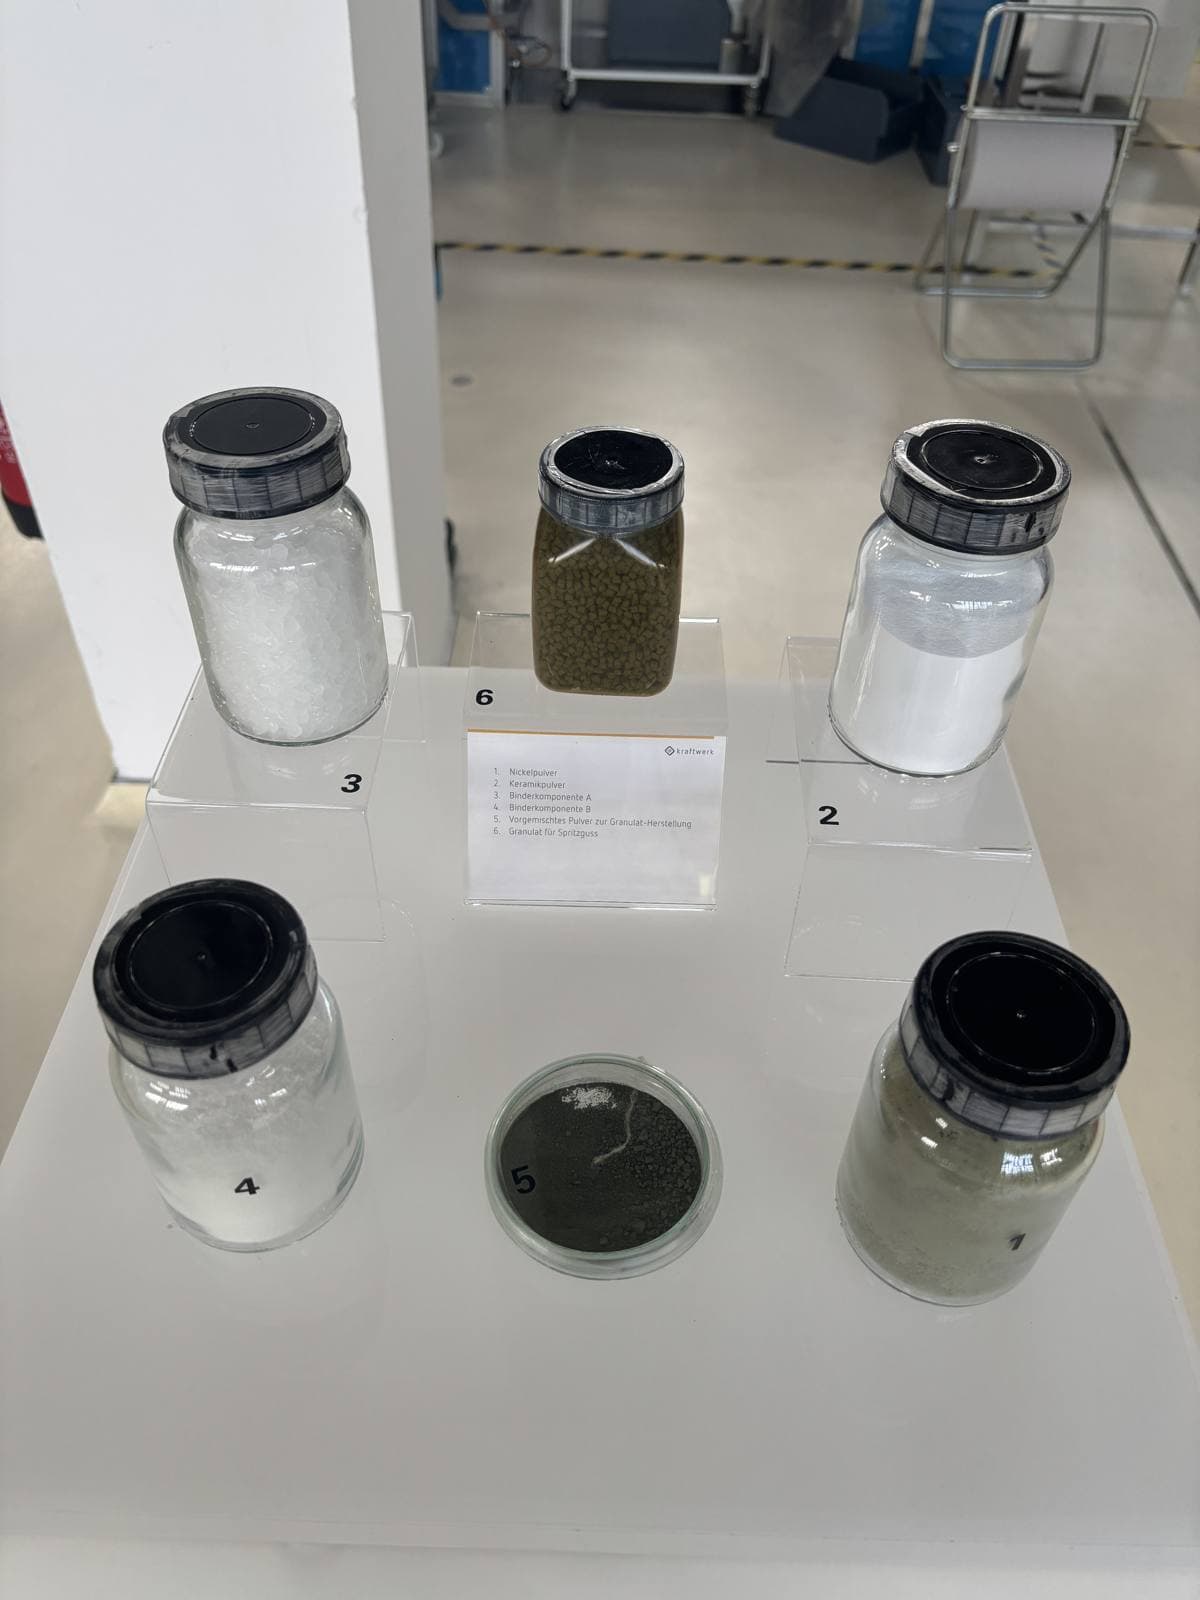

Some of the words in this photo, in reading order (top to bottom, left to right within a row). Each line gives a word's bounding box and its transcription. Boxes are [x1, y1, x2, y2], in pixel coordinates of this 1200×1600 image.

[475, 689, 494, 706] 6
[676, 747, 714, 755] kraftwerk
[494, 767, 500, 776] 1.
[509, 768, 558, 777] Nickelpulver
[340, 773, 363, 793] 3
[494, 779, 500, 788] 2.
[509, 780, 566, 790] Keramikpulver
[494, 791, 500, 800] 3.
[509, 792, 584, 802] Binderkomponente
[493, 803, 500, 811] 4.
[509, 804, 584, 814] Binderkomponente
[585, 805, 591, 813] B
[818, 805, 840, 826] 2
[493, 815, 501, 823] 5.
[509, 816, 566, 825] Vorgemischtes
[568, 817, 592, 825] Pulver
[595, 818, 608, 826] zur
[609, 818, 692, 829] Granulat-Herstellung
[493, 827, 501, 835] 6.
[509, 827, 543, 836] Granulat
[544, 828, 556, 836] für
[558, 828, 598, 838] Spritzguss
[234, 1177, 260, 1195] 4
[511, 1165, 536, 1194] 5
[1008, 1233, 1027, 1251] 1
